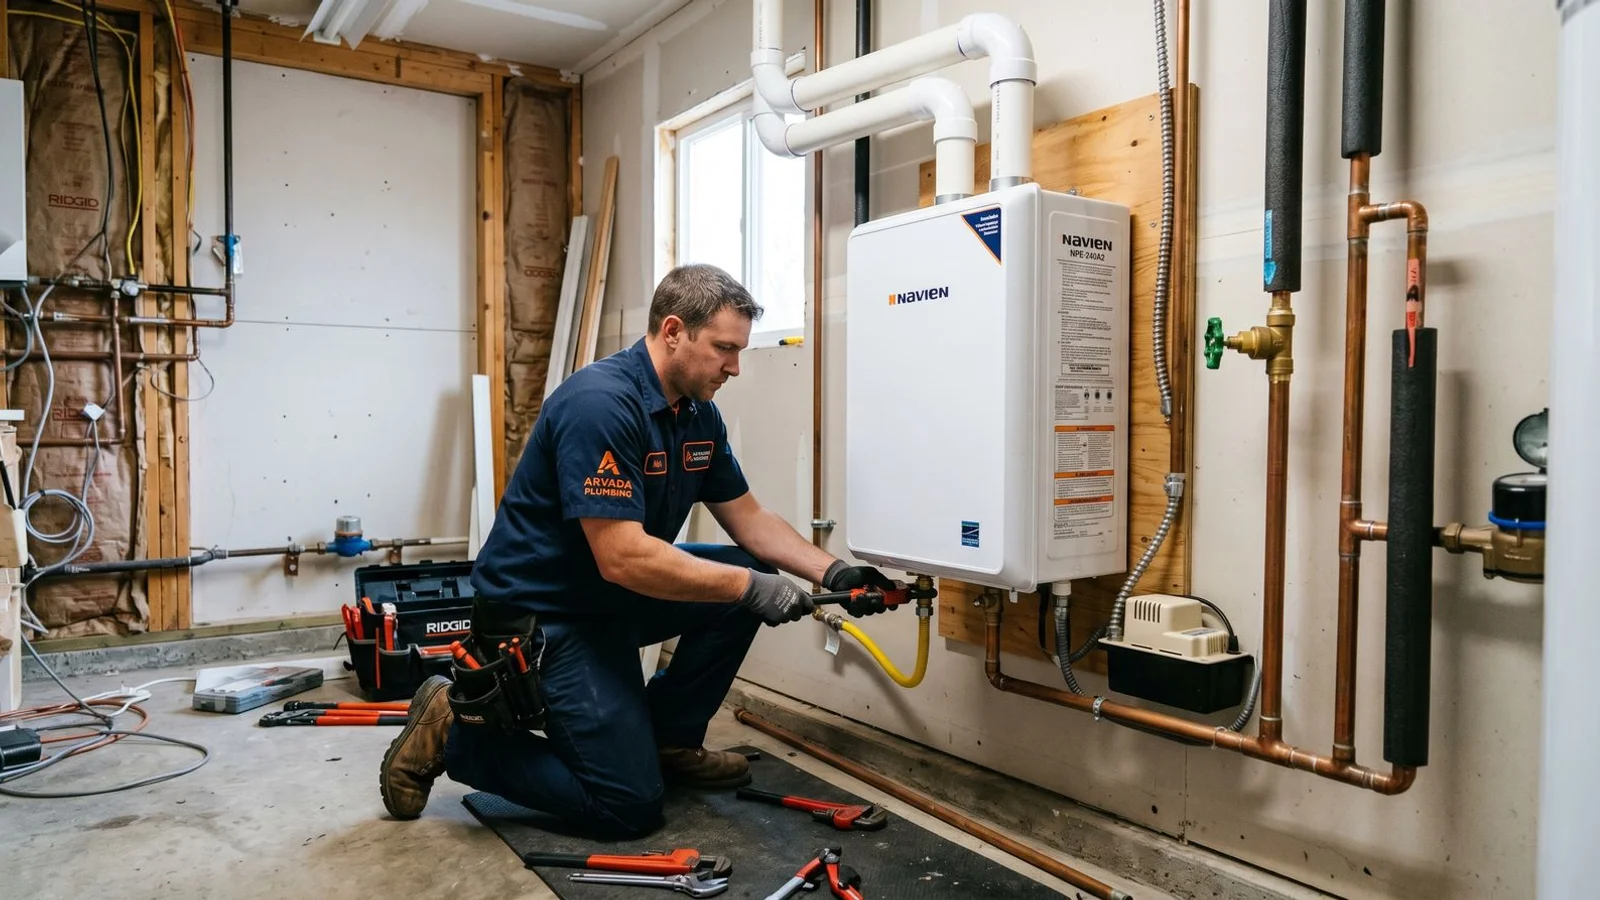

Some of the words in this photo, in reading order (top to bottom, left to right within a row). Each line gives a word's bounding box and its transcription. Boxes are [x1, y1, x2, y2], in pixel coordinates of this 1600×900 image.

[48, 194, 99, 208] RIDGID
[1070, 249, 1105, 261] NPE-240A2
[584, 477, 632, 489] ARVADA
[584, 488, 632, 498] PLUMBING
[426, 619, 471, 633] RIDGID
